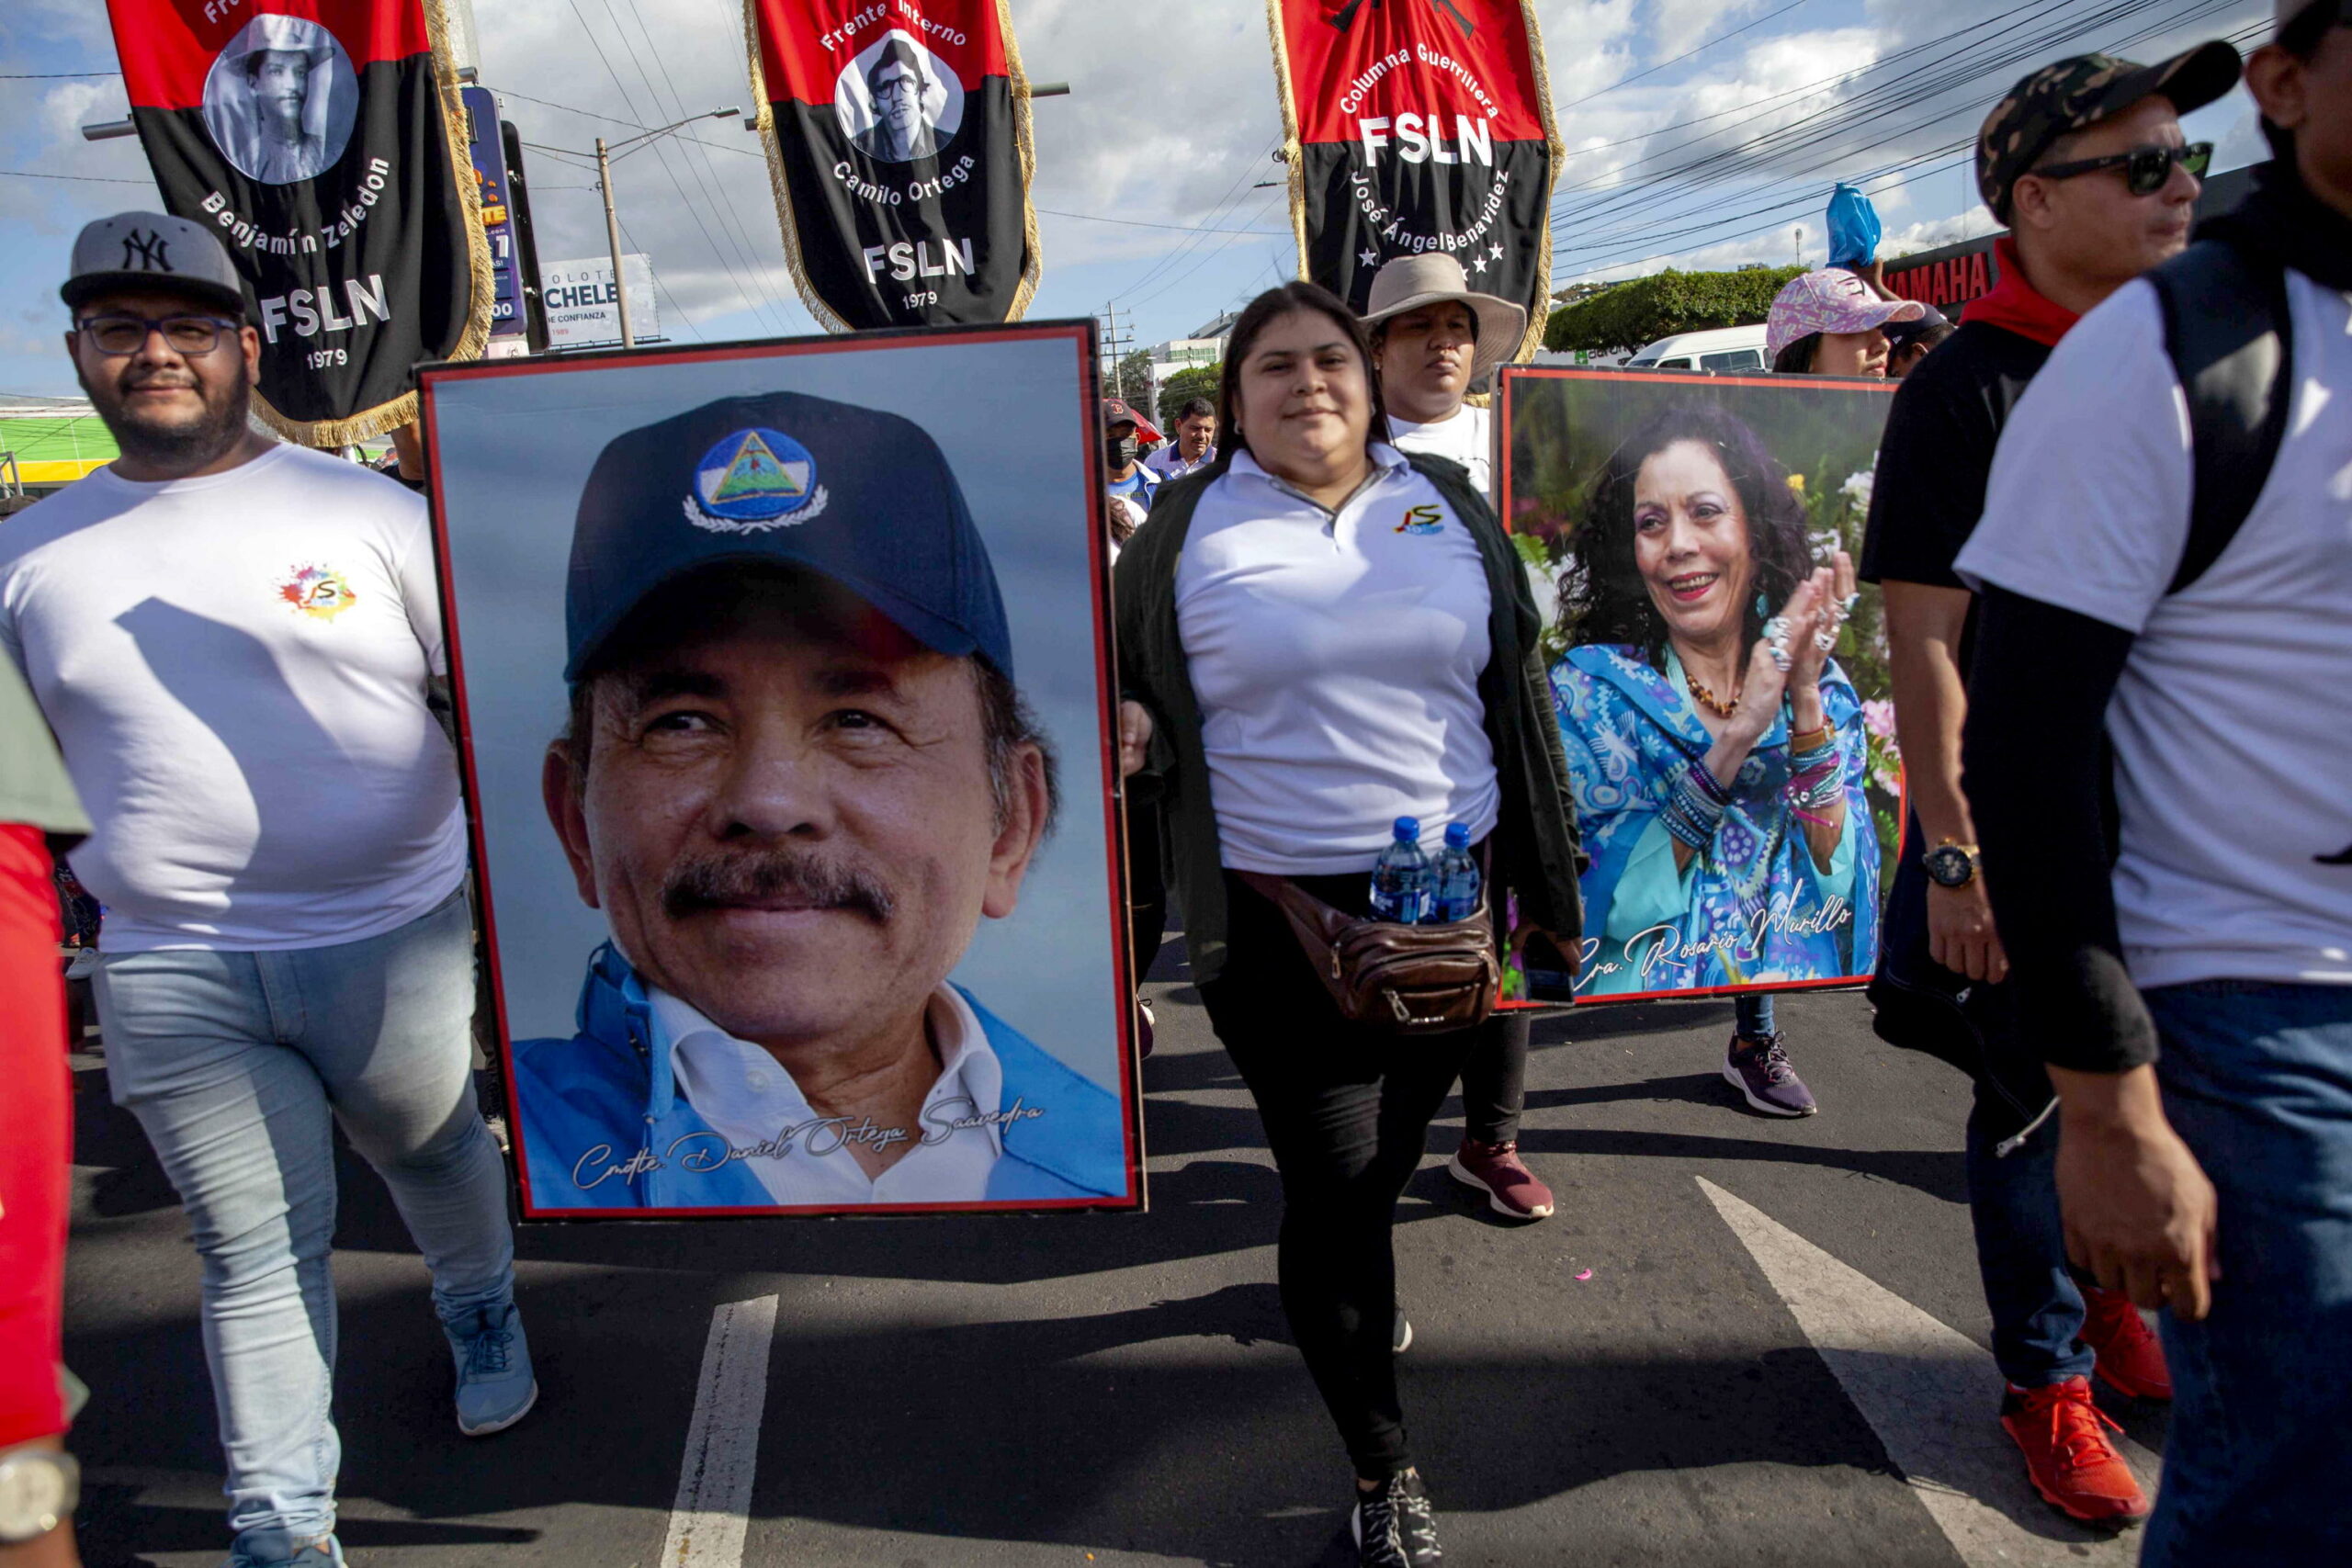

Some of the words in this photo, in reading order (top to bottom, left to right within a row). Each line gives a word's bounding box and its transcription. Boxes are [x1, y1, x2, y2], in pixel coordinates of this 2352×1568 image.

[820, 2, 888, 52] Frente
[898, 0, 967, 46] Interno
[1340, 48, 1411, 115] Columna
[1417, 42, 1499, 119] Guerrillera
[1359, 112, 1493, 167] FSLN
[833, 161, 901, 206] Camilo
[909, 155, 976, 201] Ortega
[1351, 171, 1390, 223] José
[201, 191, 318, 254] Benjamín
[122, 227, 175, 272] NY
[864, 237, 976, 285] FSLN
[261, 274, 390, 344] FSLN
[558, 312, 606, 323] CONFIANZA
[903, 291, 937, 310] 1979
[307, 348, 348, 370] 1979
[1623, 924, 1738, 977] Rosario
[1750, 877, 1852, 952] Murillo
[666, 1131, 793, 1172] Daniel
[787, 1115, 909, 1157] Ortega
[920, 1096, 1046, 1146] Saavedra
